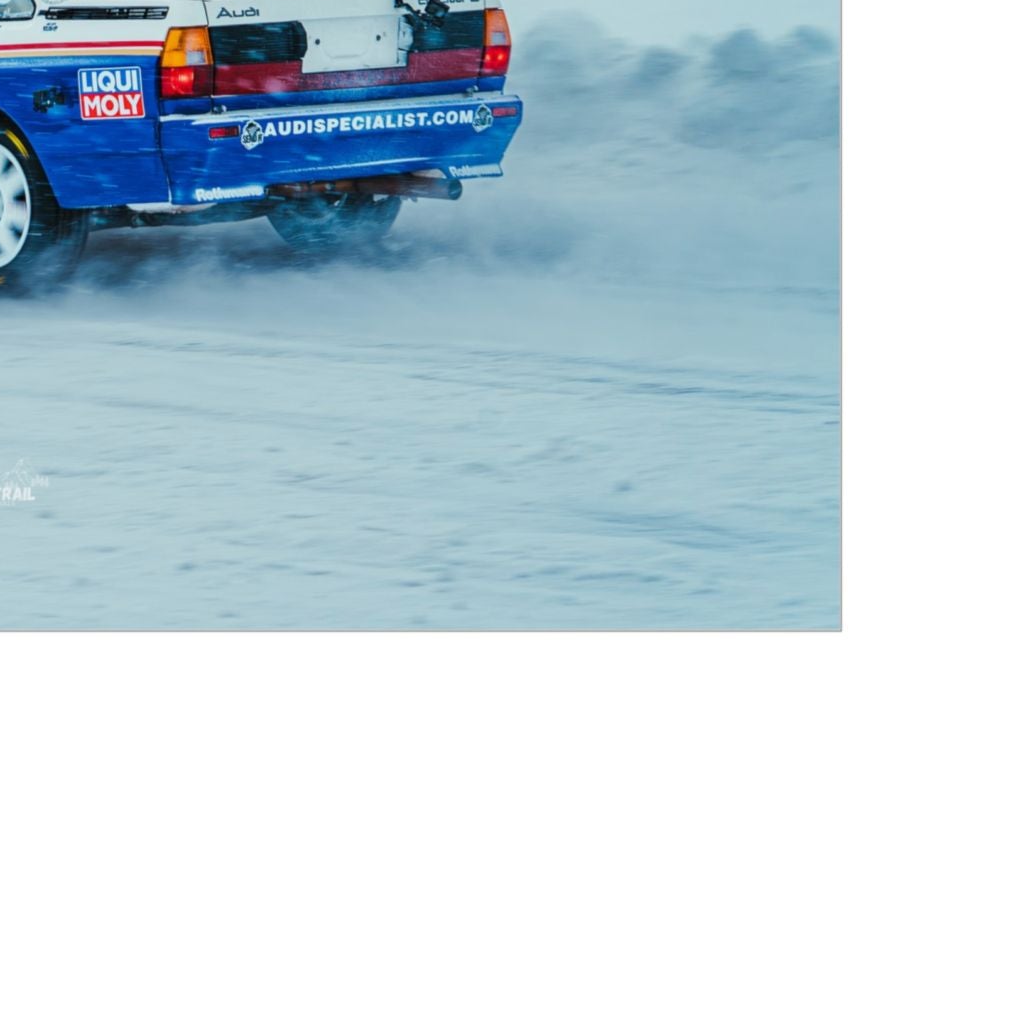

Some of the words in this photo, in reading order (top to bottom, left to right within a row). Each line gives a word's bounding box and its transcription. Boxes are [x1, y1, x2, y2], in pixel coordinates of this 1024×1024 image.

[216, 6, 260, 19] Audi
[81, 69, 139, 93] LIQUI
[83, 94, 141, 117] MOLY
[263, 110, 474, 138] AUDISPECIALIST.COM
